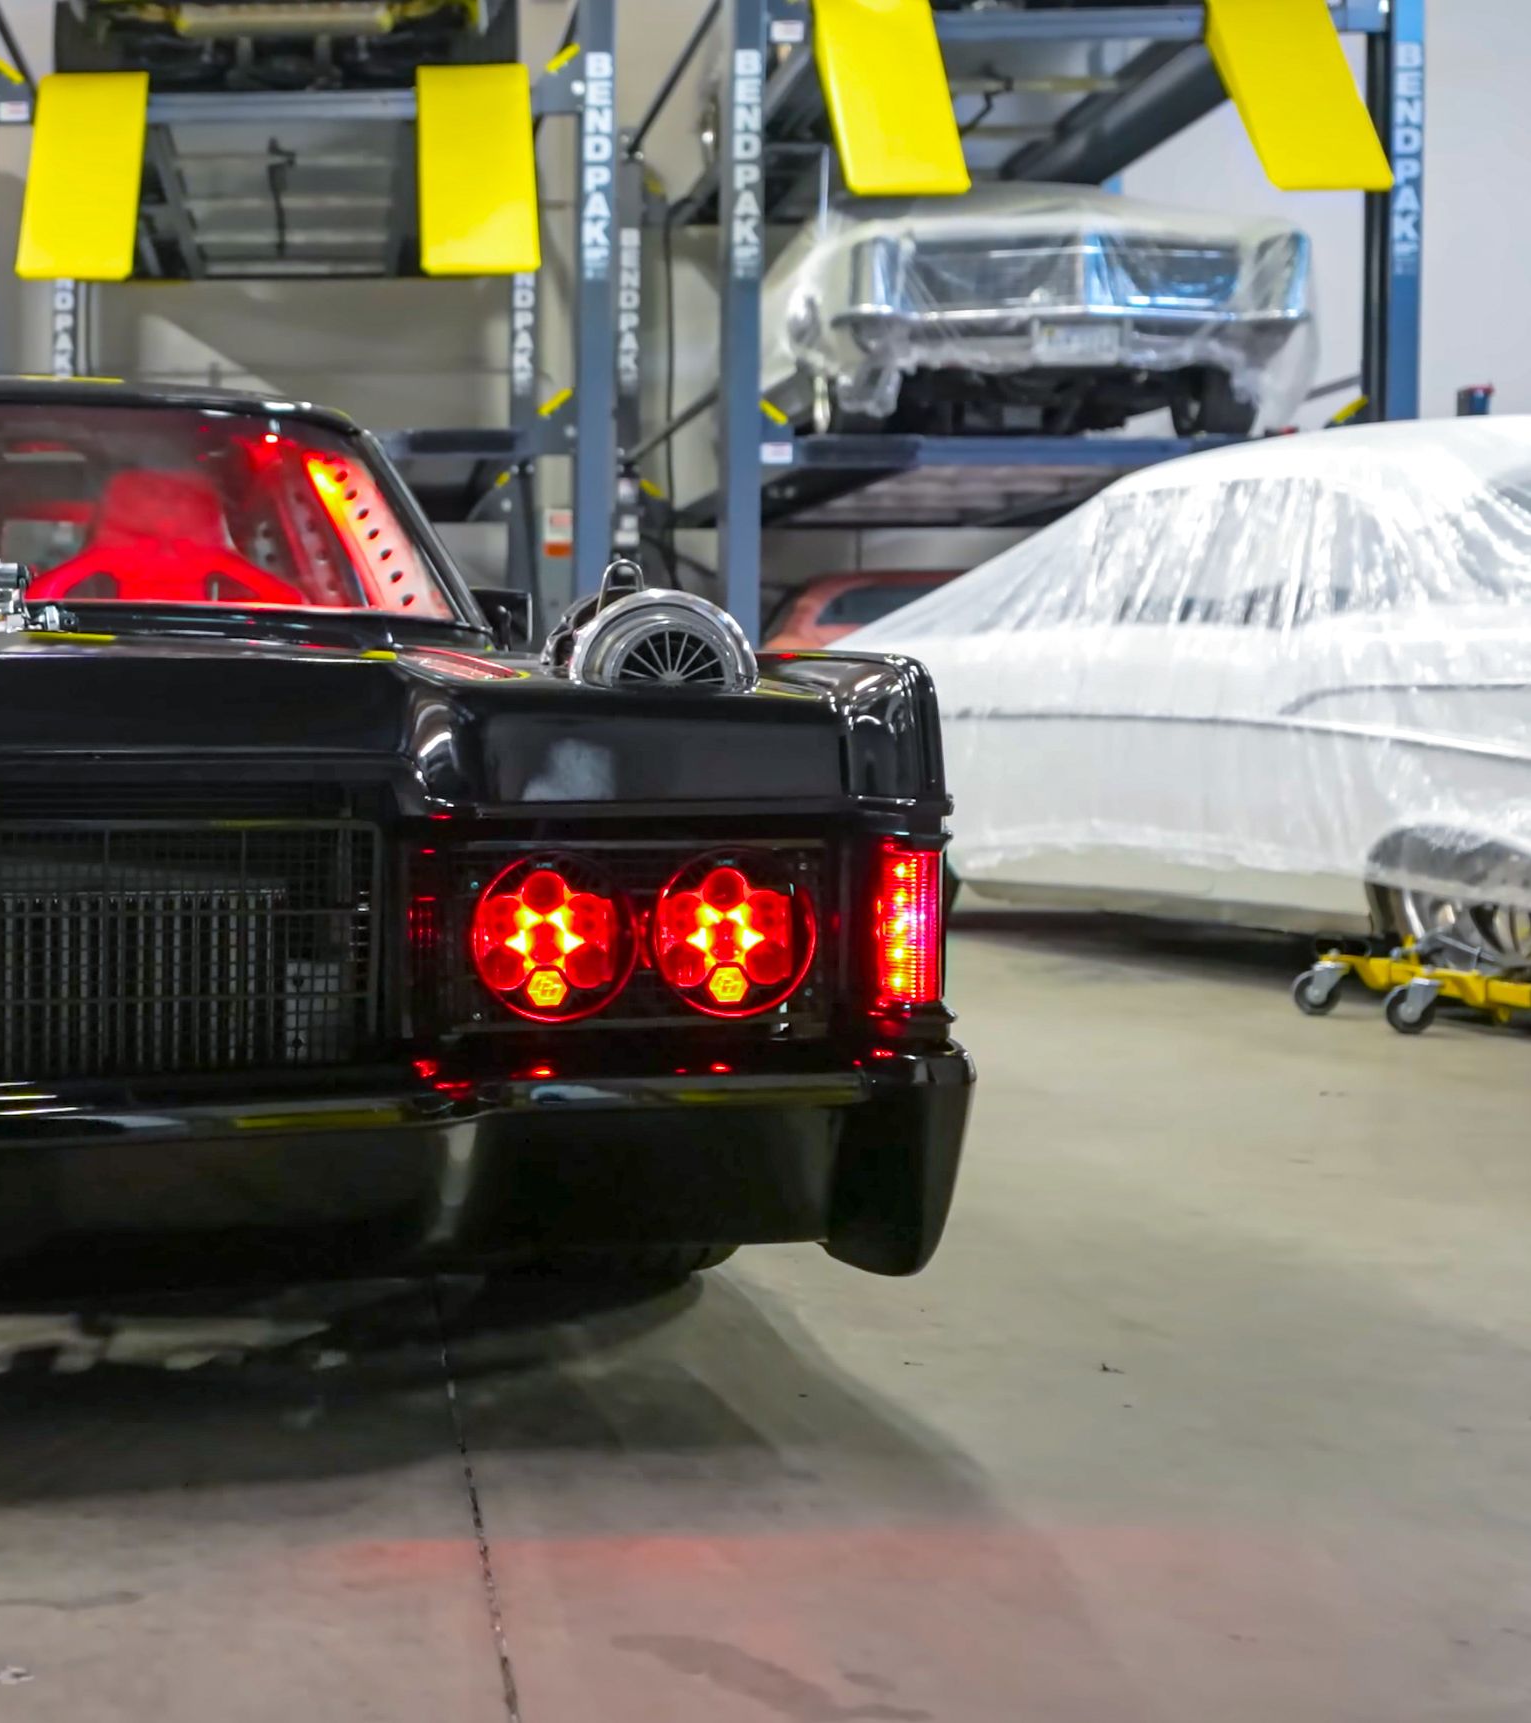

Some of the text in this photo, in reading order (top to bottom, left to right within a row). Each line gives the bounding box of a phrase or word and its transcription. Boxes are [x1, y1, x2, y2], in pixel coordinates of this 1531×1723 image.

[583, 52, 612, 246] BENDPAK
[733, 49, 761, 244] BENDPAK
[1394, 41, 1422, 241] BENDPAK
[621, 228, 640, 367] BENDPAK
